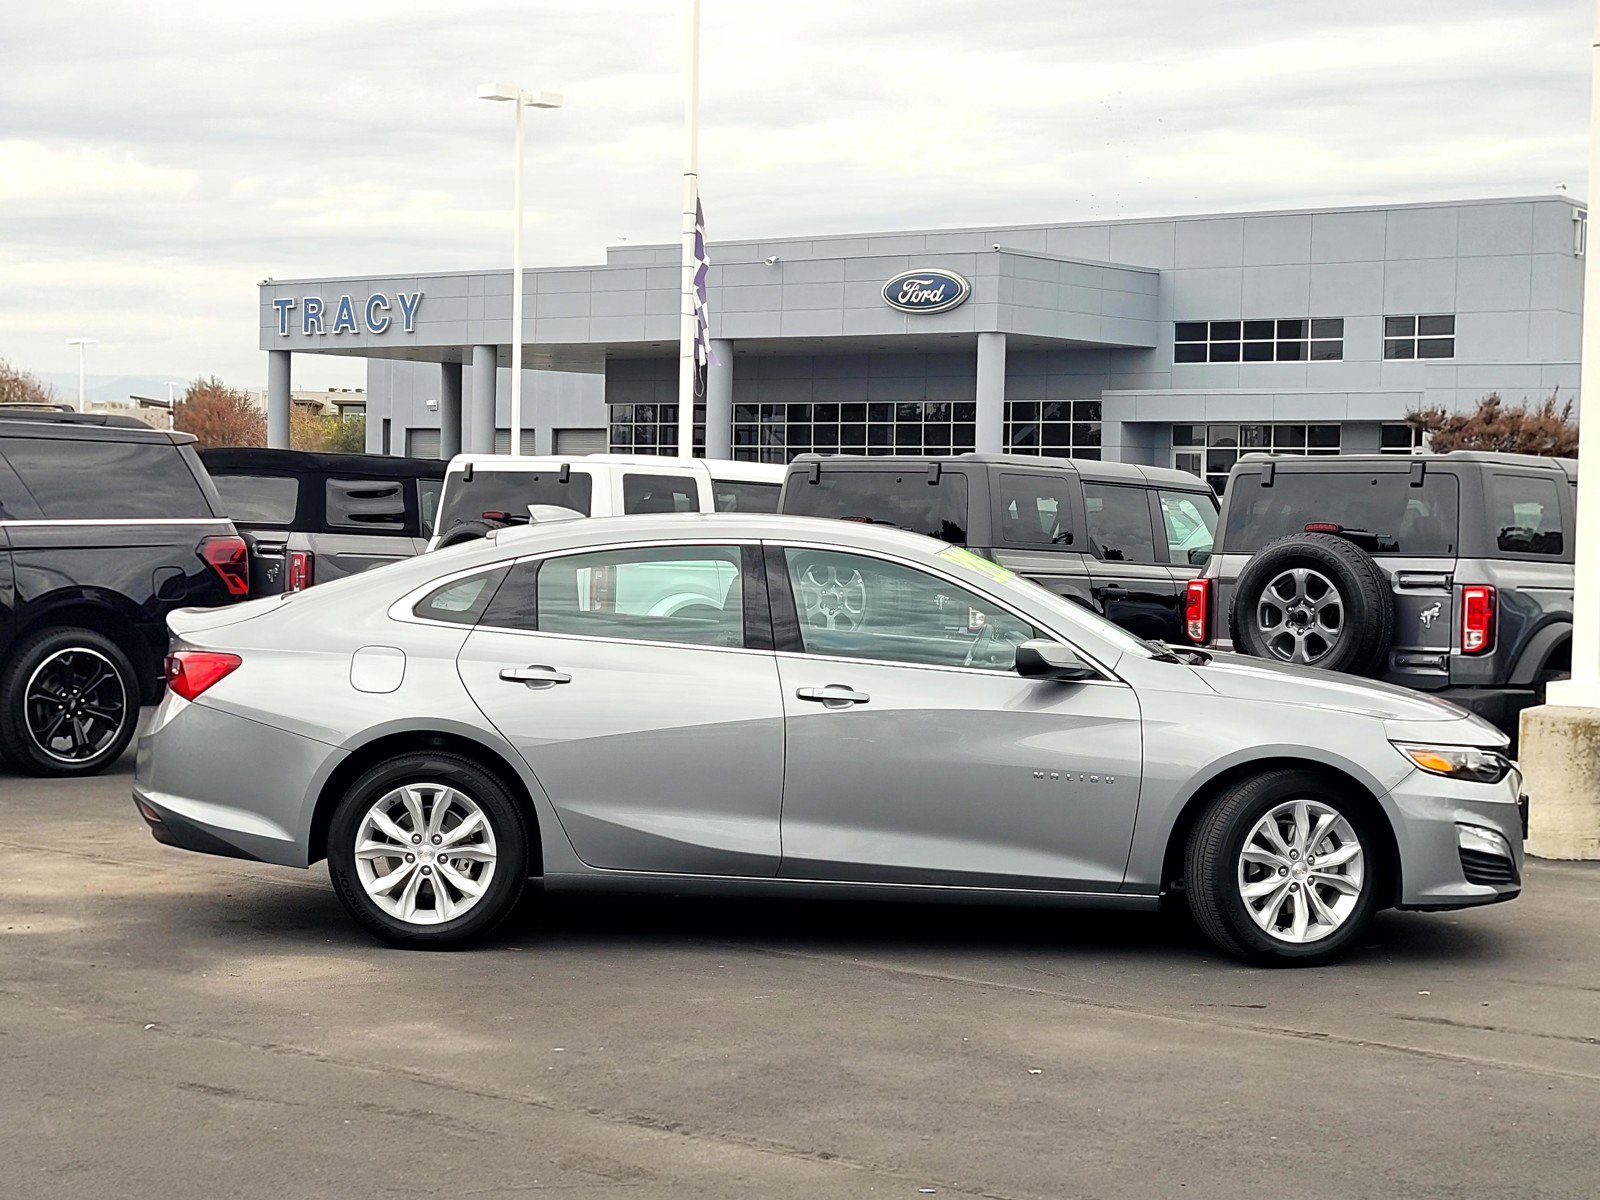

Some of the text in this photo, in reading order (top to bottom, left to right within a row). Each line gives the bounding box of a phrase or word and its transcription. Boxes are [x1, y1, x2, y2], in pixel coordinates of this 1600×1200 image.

[898, 279, 946, 304] Ford
[273, 291, 424, 337] TRACY
[1033, 771, 1115, 785] MALIBU
